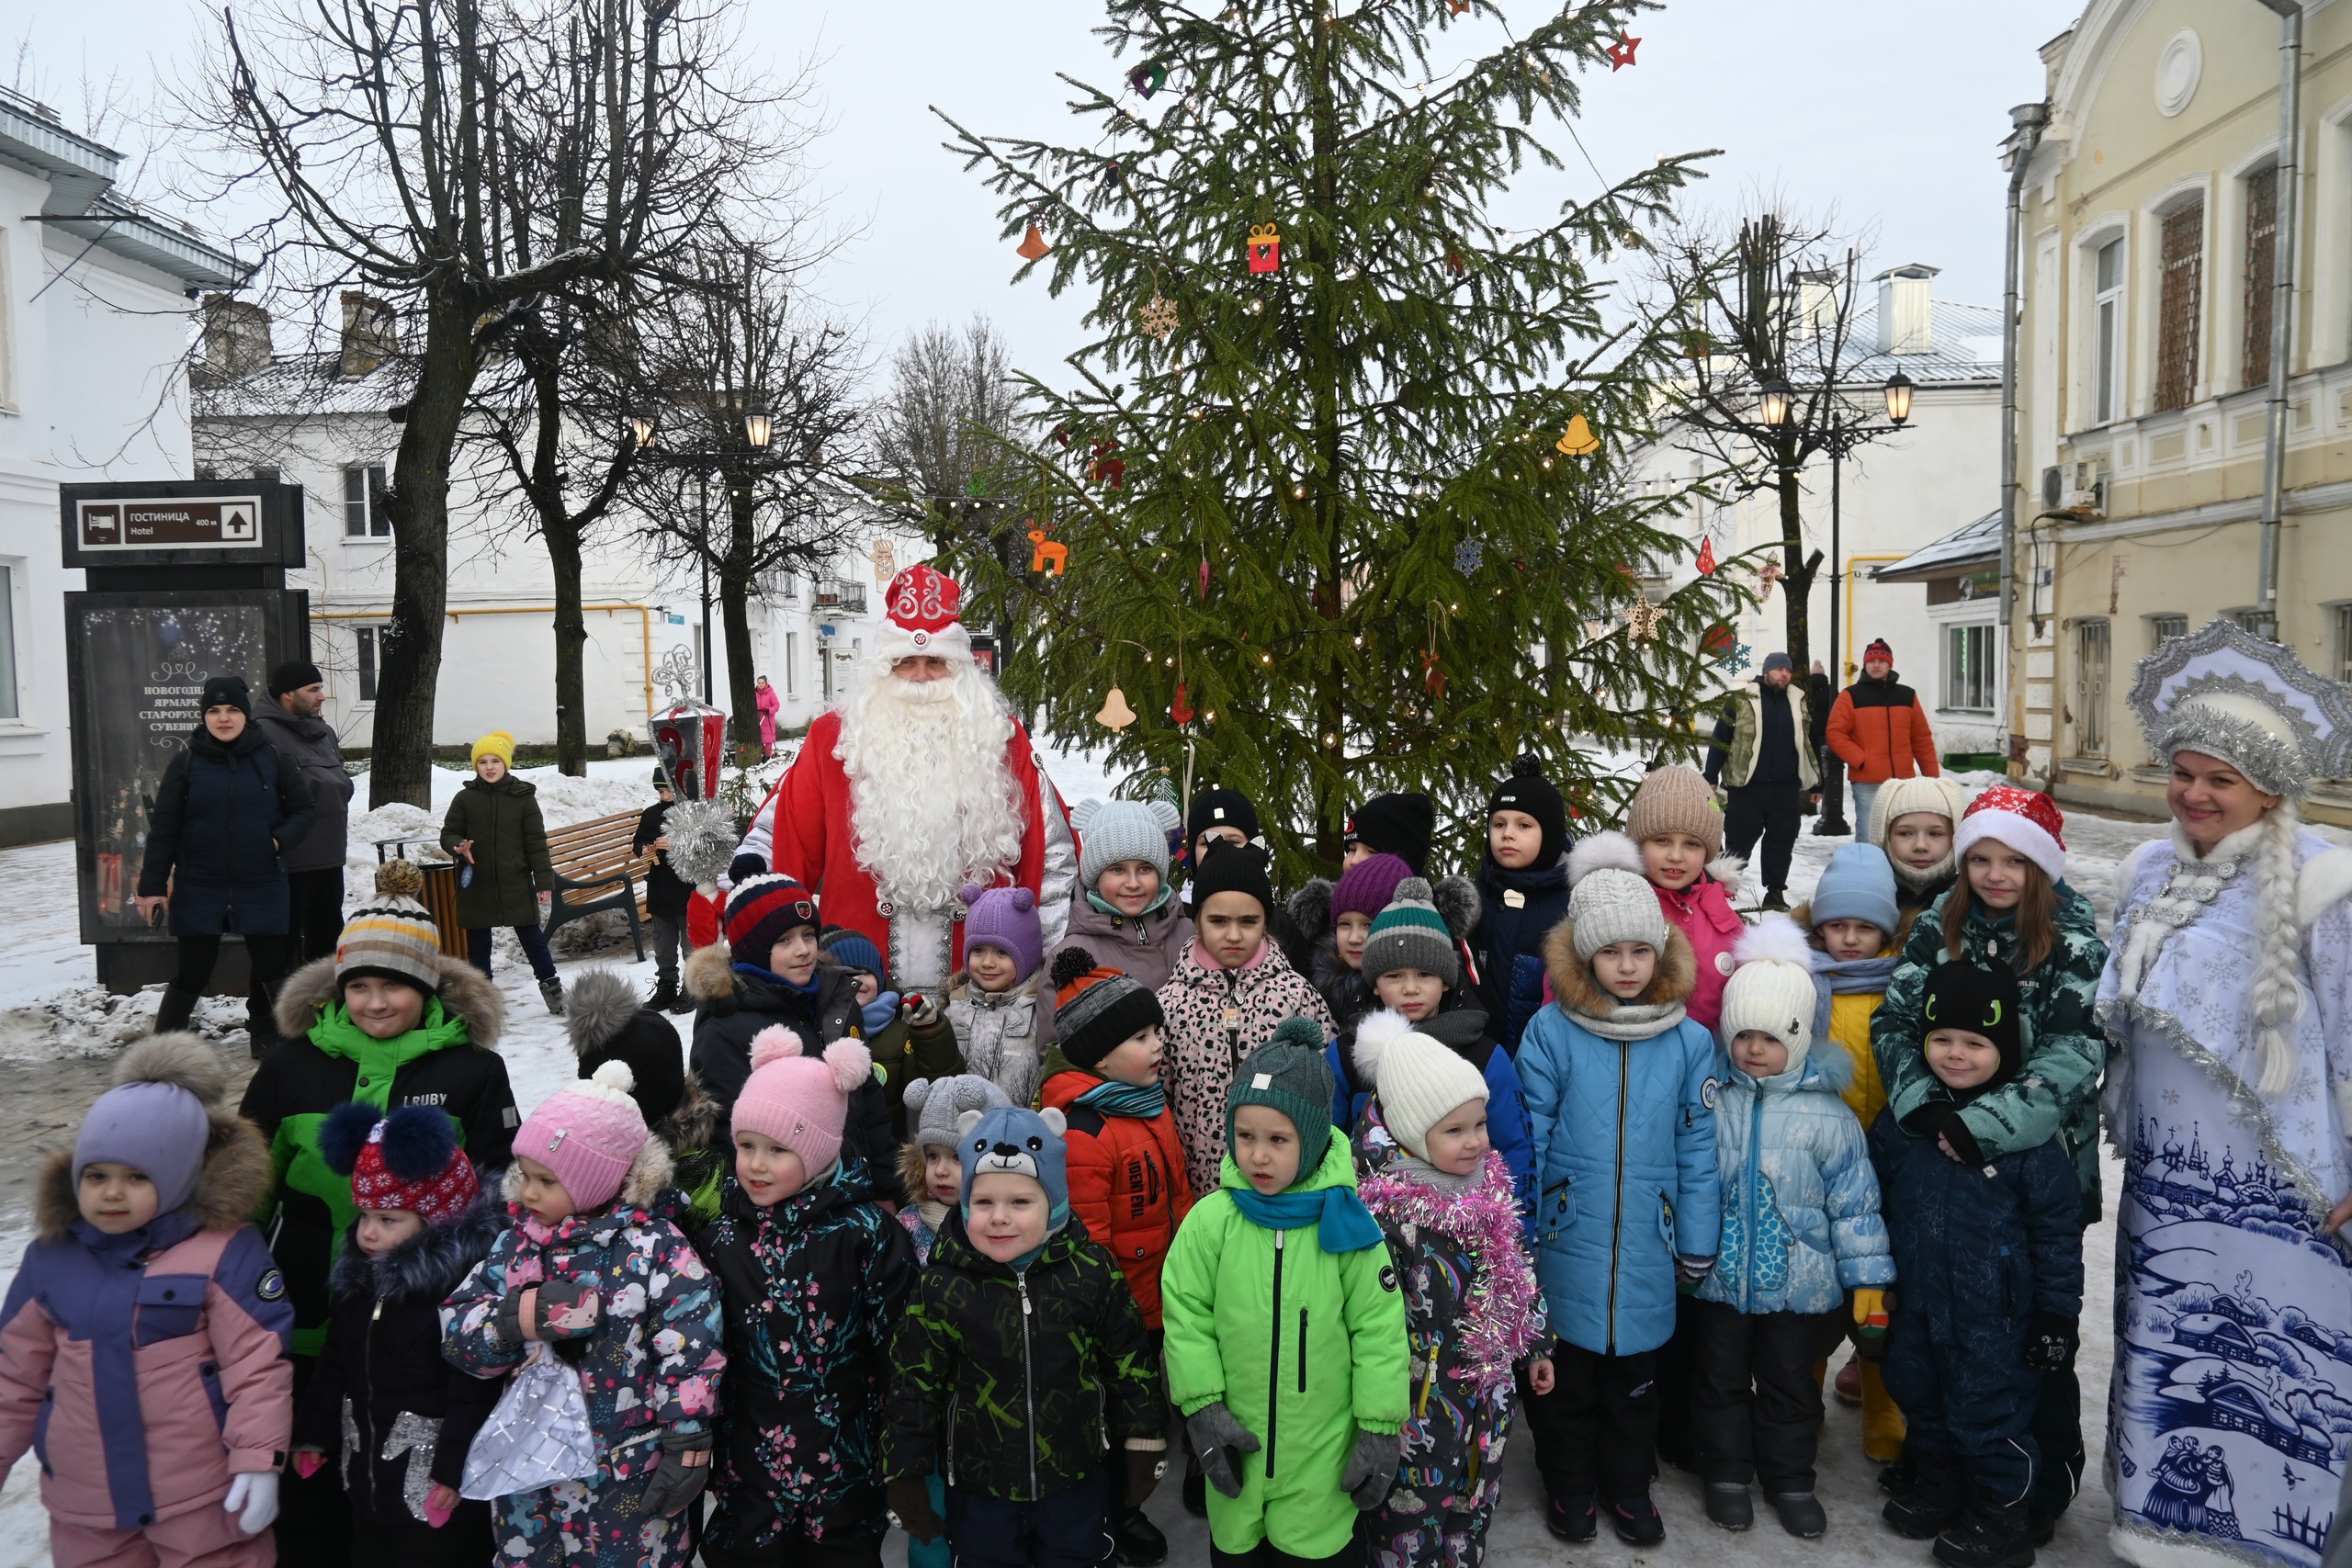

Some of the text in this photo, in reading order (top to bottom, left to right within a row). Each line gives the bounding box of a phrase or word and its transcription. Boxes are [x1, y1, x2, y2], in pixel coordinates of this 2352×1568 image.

[130, 512, 190, 523] ГОСТИНИЦА
[130, 526, 153, 535] Hotel
[153, 698, 200, 707] ЯРМАРК
[139, 710, 201, 719] СТАРОРУСС
[150, 722, 201, 731] СУВЕНИР
[1131, 1195, 1145, 1220] EVIL
[1398, 1466, 1443, 1487] HELLO
